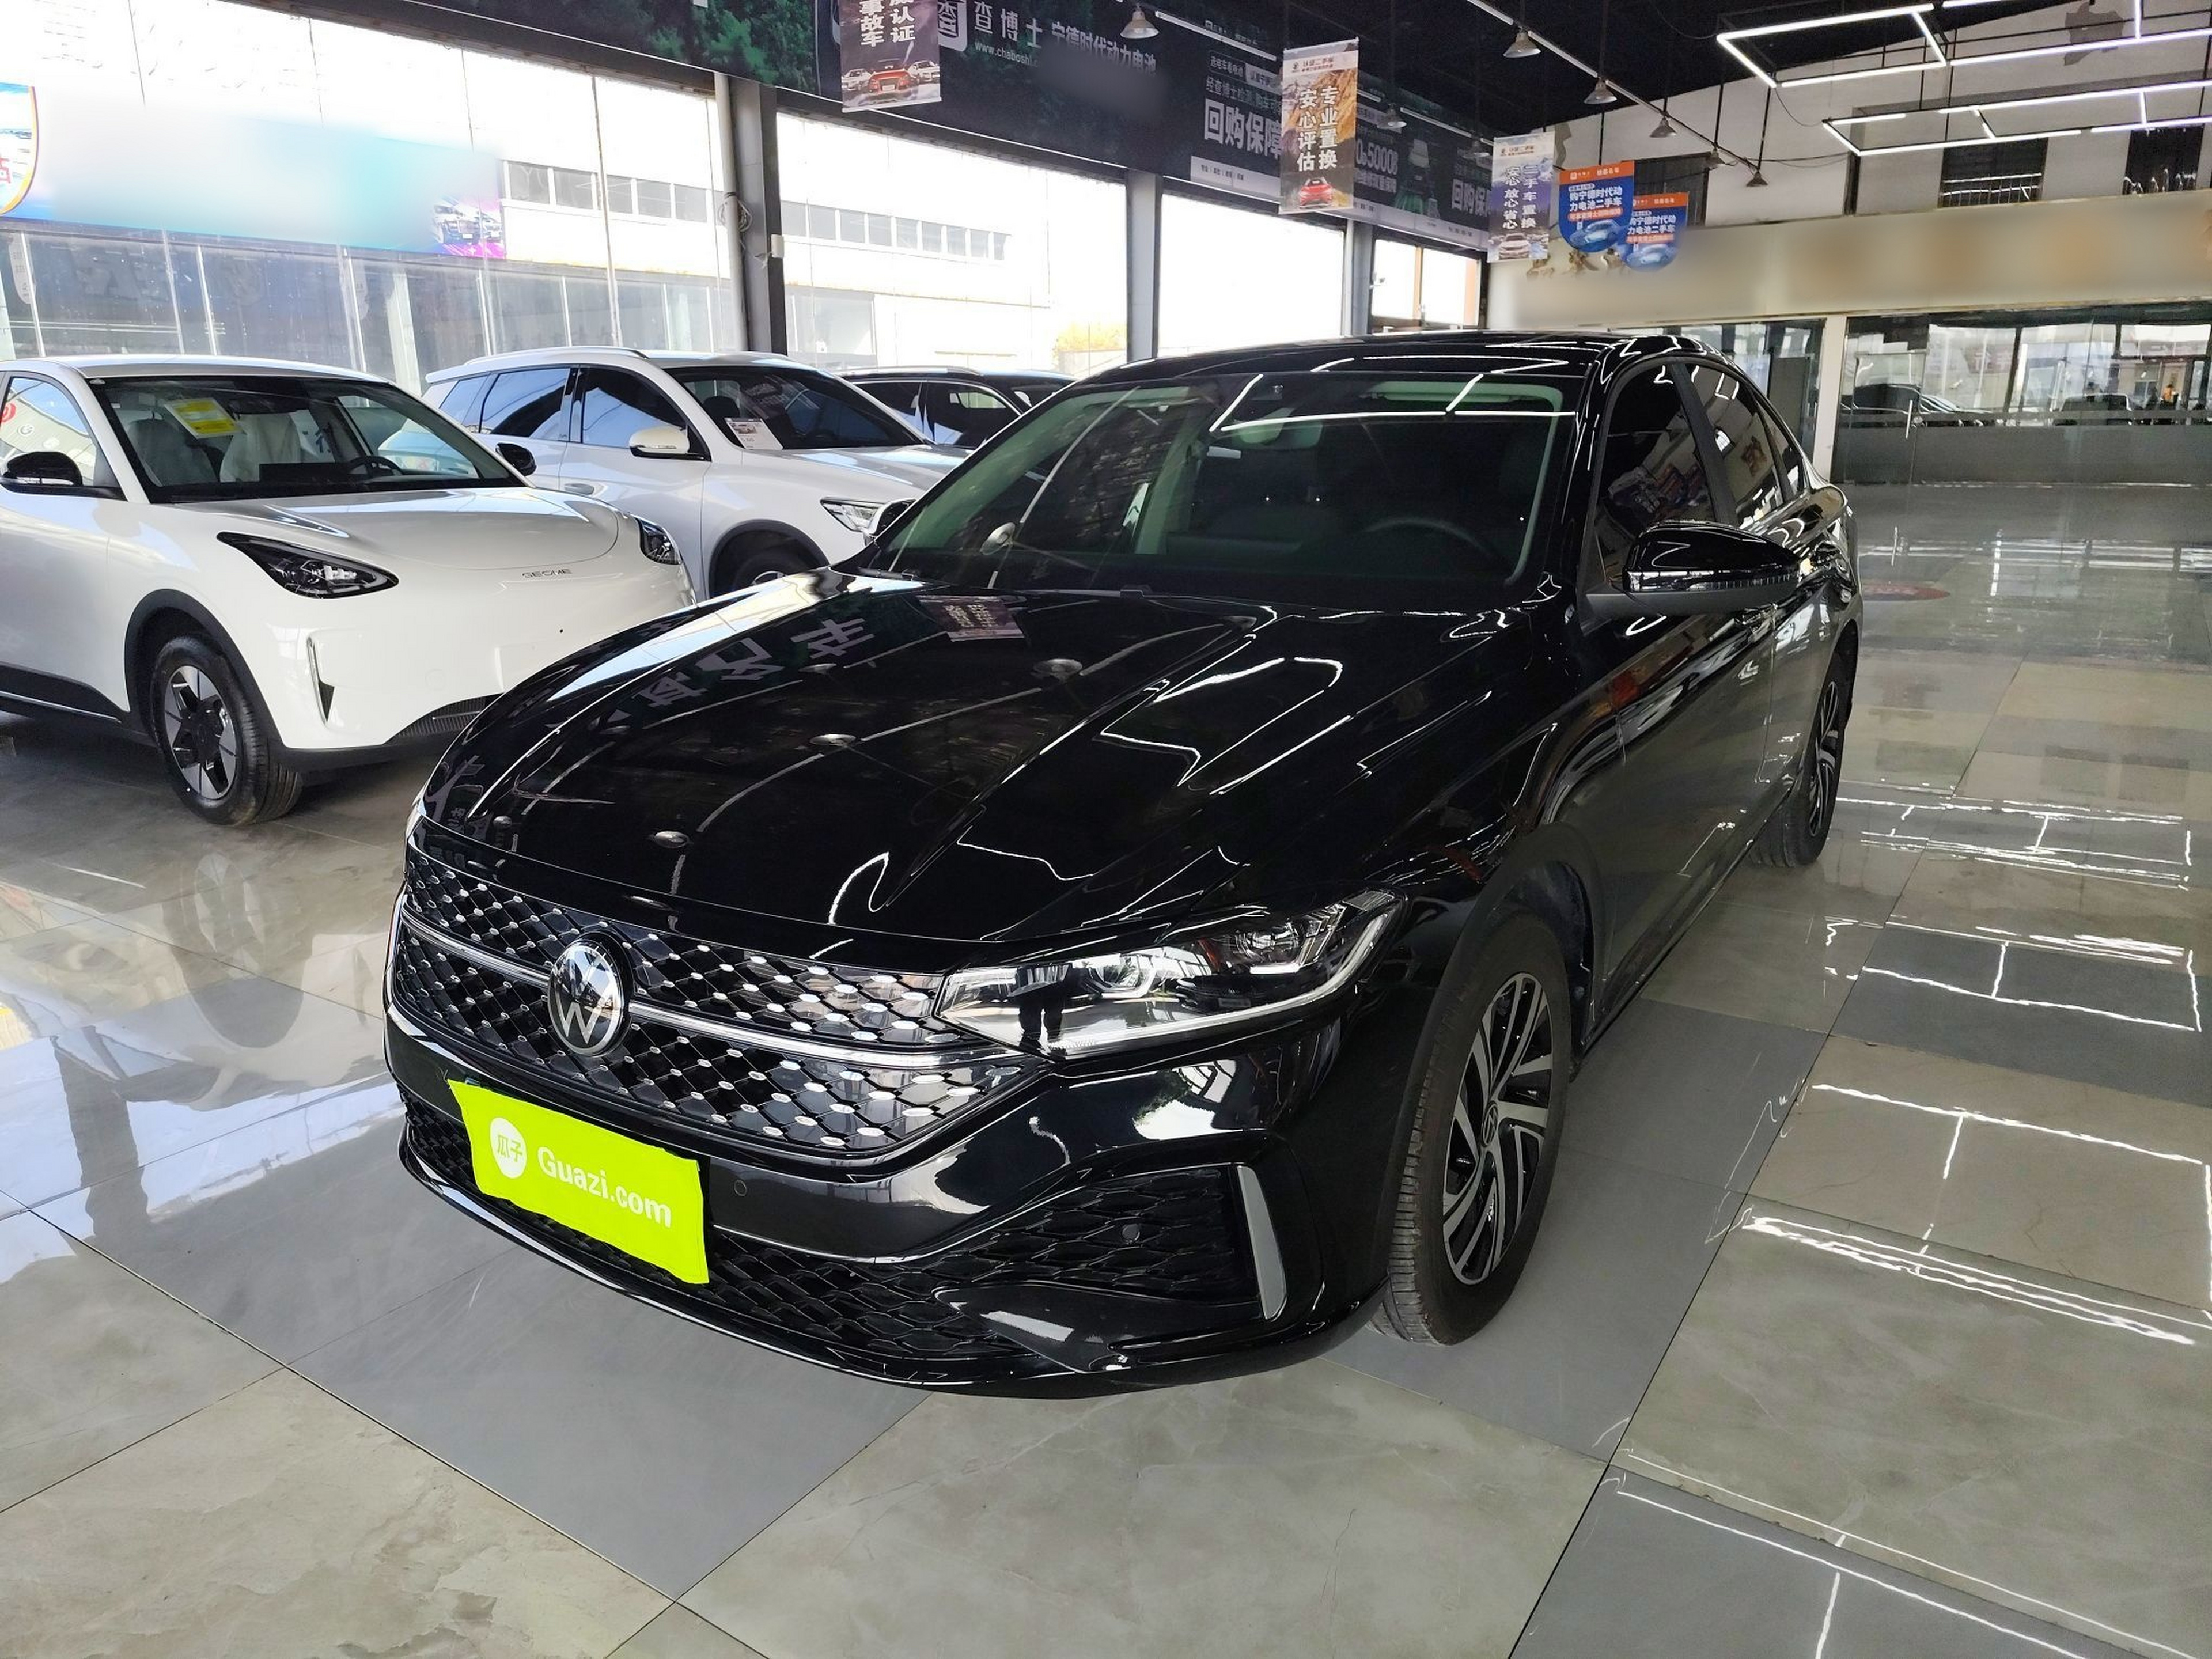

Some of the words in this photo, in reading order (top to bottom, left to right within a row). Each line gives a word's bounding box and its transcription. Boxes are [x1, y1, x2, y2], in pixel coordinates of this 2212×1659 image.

[974, 1, 1043, 48] 查博士
[1297, 89, 1317, 172] 安心评估
[1319, 85, 1339, 170] 专业置换
[1521, 164, 1539, 229] 二手车置换
